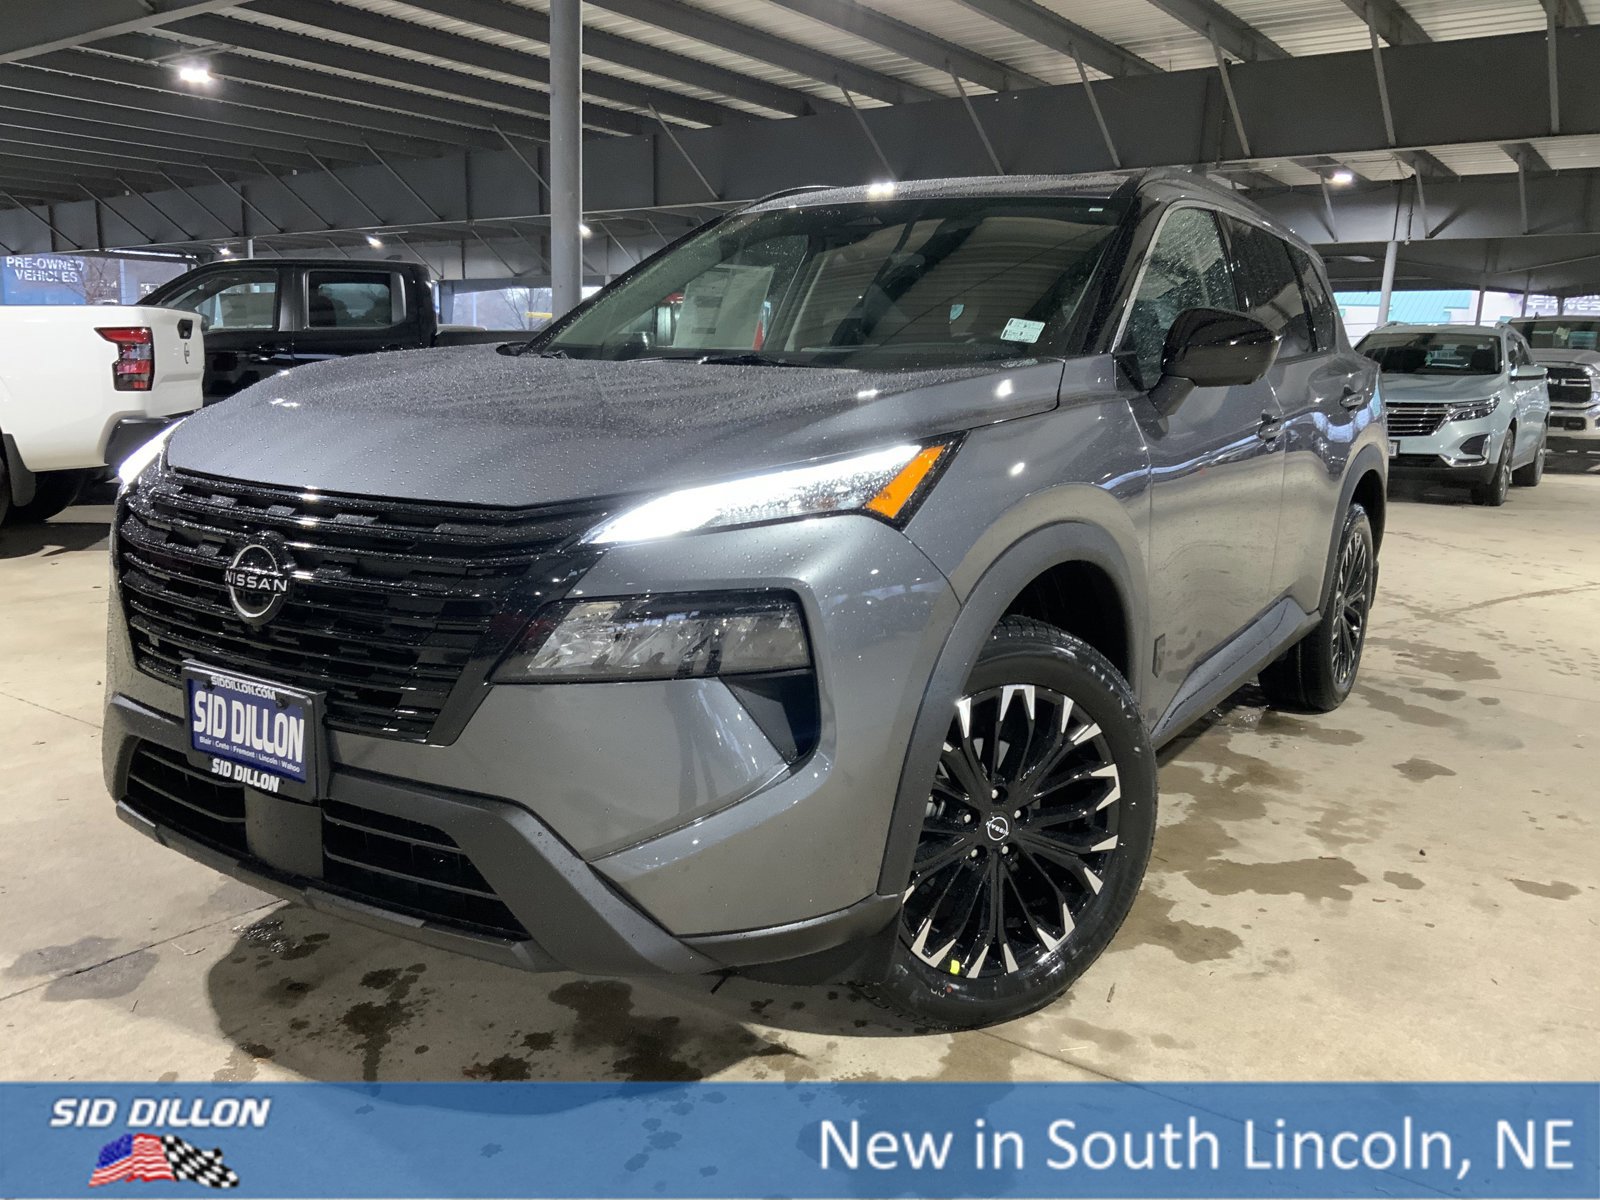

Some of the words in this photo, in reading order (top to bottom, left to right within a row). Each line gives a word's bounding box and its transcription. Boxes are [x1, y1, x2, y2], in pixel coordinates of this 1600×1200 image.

[15, 269, 78, 282] VEHICLES
[225, 570, 287, 591] NISSAN
[210, 675, 276, 700] SIDDILLON.COM
[194, 691, 227, 738] SID
[231, 700, 304, 763] DILLON
[259, 754, 278, 765] Lincoln
[211, 758, 231, 777] SID
[234, 765, 280, 793] DILLON
